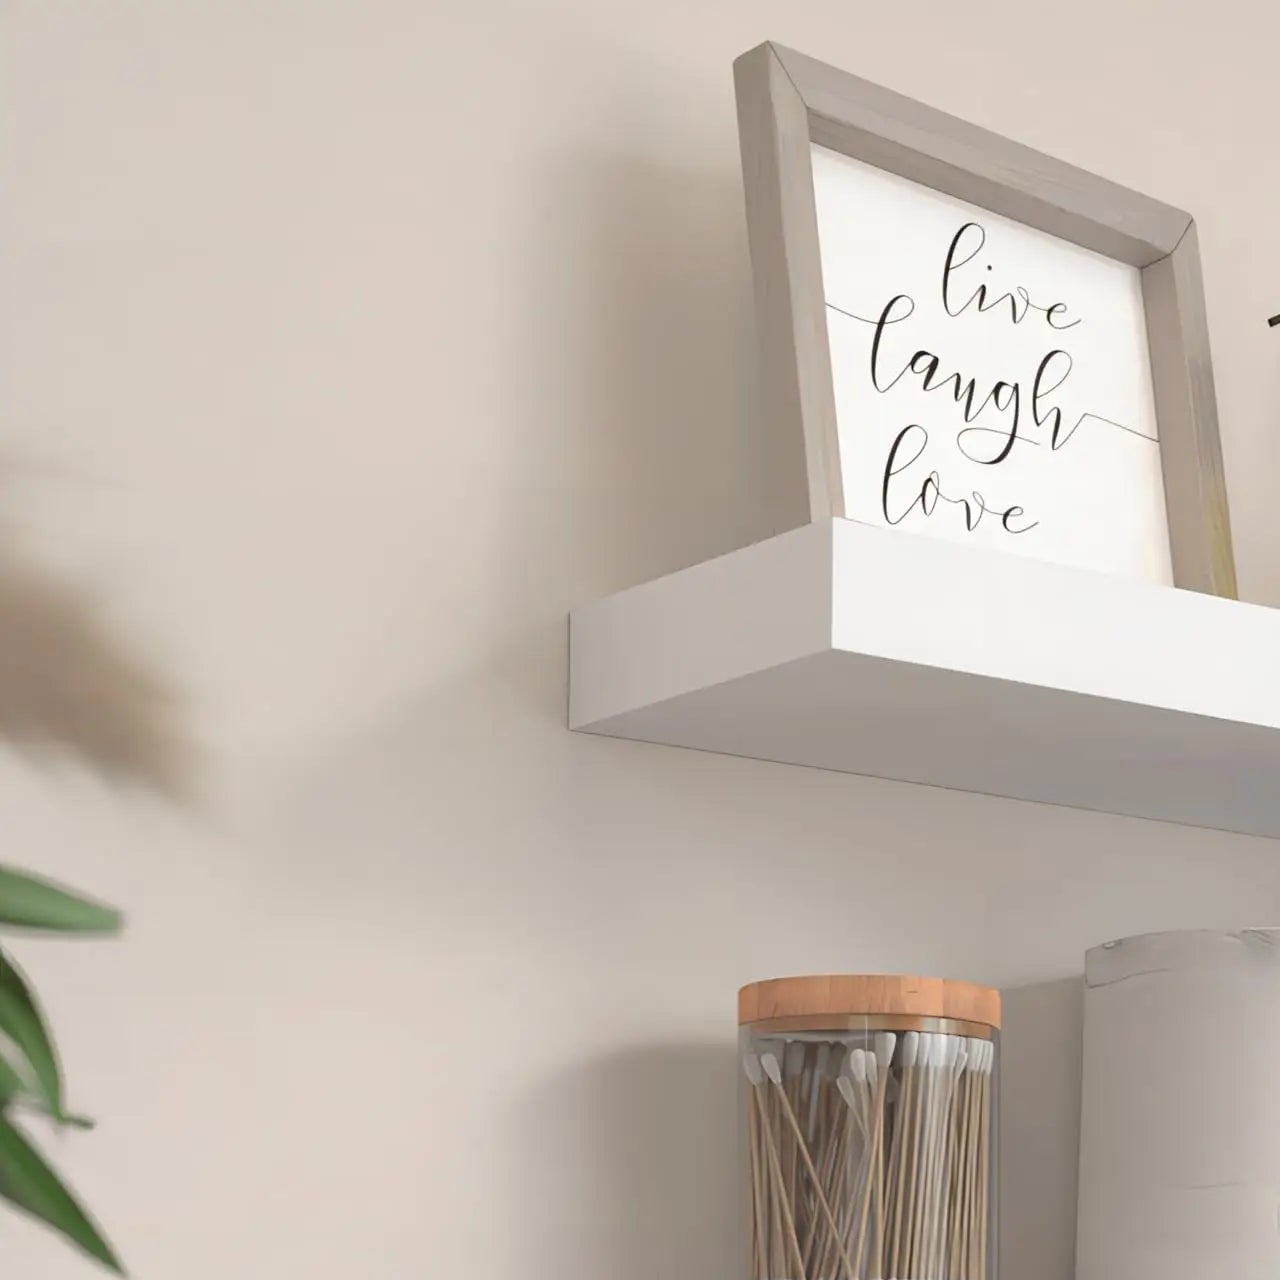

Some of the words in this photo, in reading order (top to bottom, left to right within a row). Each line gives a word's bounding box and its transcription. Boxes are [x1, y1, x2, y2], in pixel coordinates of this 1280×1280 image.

[942, 222, 1082, 330] live
[825, 294, 1160, 465] laugh
[882, 424, 1040, 534] love
